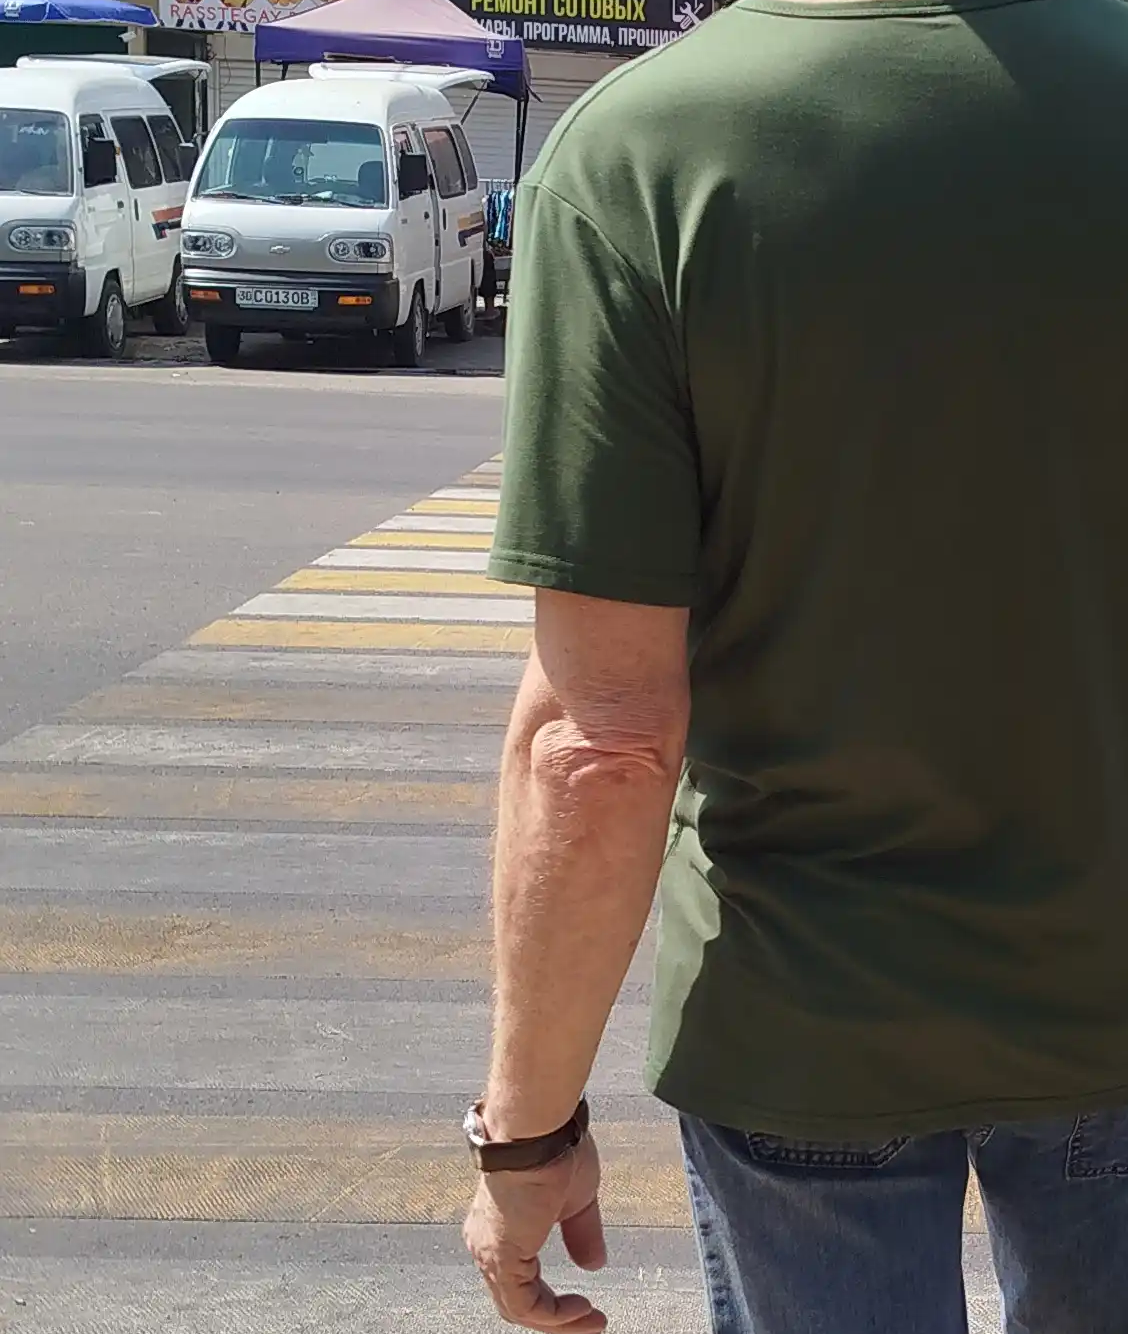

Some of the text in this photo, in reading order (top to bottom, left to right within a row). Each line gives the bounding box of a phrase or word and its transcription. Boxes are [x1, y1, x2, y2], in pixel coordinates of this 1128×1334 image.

[170, 4, 281, 24] RASSTEGAY
[523, 21, 616, 47] ПРОГРАММА,
[618, 27, 686, 48] ПРОШИВ
